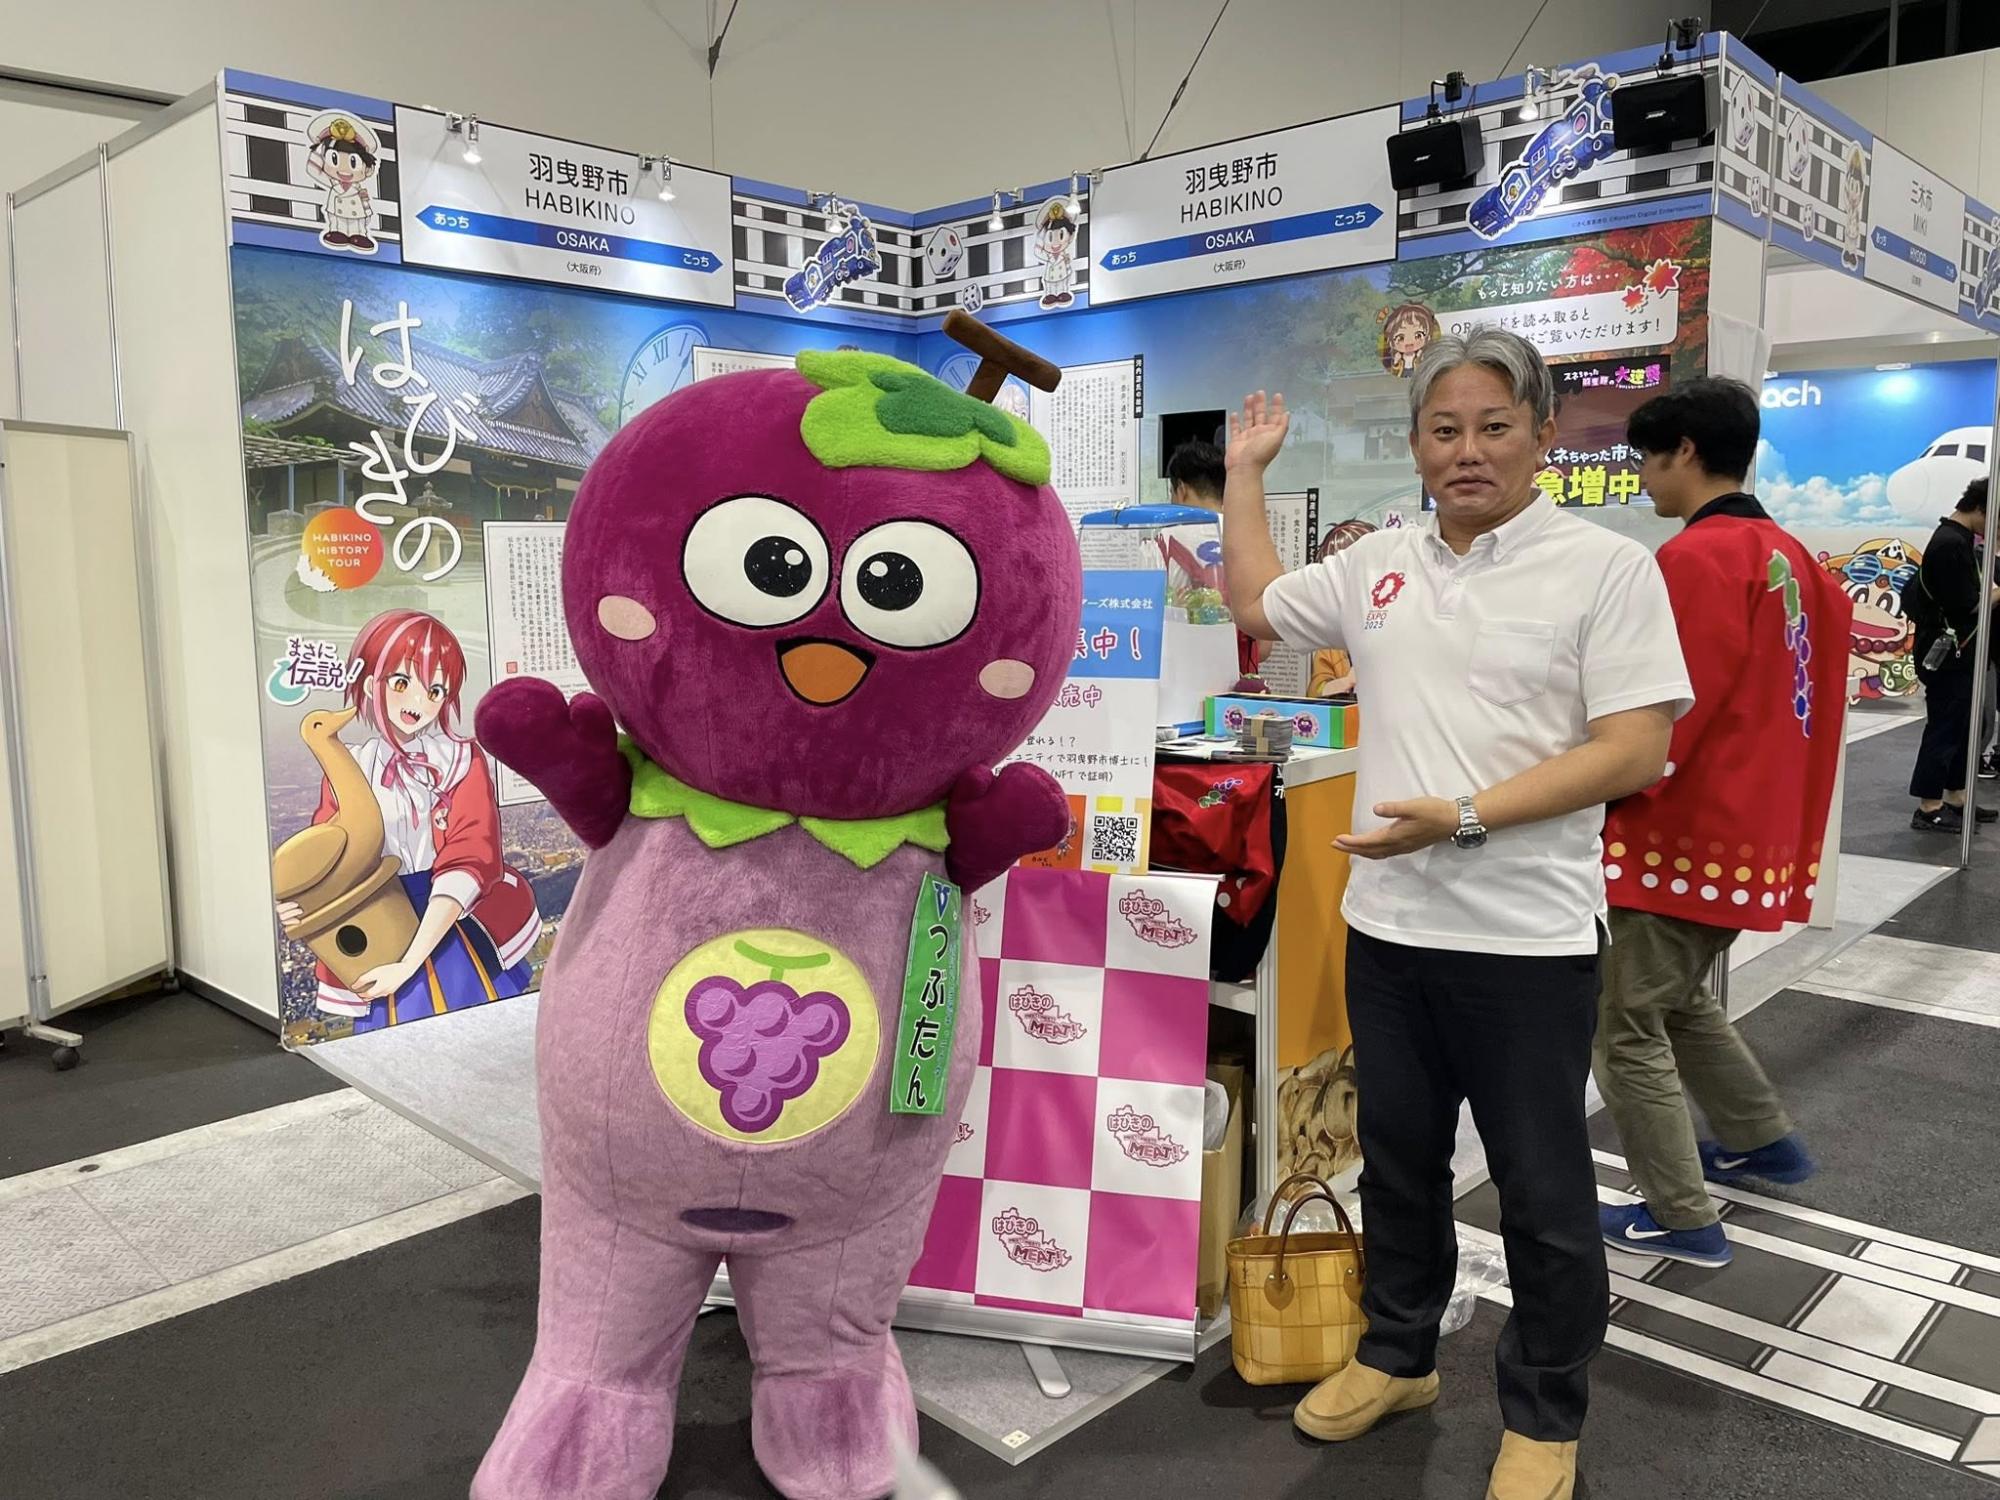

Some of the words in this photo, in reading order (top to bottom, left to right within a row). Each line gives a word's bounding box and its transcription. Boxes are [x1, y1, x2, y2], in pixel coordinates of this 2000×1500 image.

[529, 153, 629, 196] 羽曳野市
[1186, 153, 1278, 194] 羽曳野市
[526, 188, 636, 226] HABIKINO
[1180, 187, 1284, 224] HABIKINO
[434, 211, 470, 229] あっち
[1334, 210, 1366, 228] こっち
[556, 230, 610, 253] OSAKA
[1205, 228, 1255, 250] OSAKA
[683, 252, 709, 268] こっち
[1112, 250, 1137, 265] あっち
[1760, 379, 1821, 409] ach
[339, 299, 480, 582] はびきの
[1535, 465, 1640, 506] 急増中
[312, 533, 372, 542] HABIKINO
[328, 558, 361, 567] TOUR
[1082, 598, 1153, 610] ーズ株式会社
[1366, 611, 1388, 620] EXPO
[1365, 621, 1384, 630] 2025
[289, 638, 334, 660] まさに
[1053, 684, 1102, 708] 売中
[1120, 899, 1162, 913] はびきの
[1141, 925, 1187, 941] MEAT!
[1011, 995, 1052, 1009] はびきの
[905, 923, 950, 1108] つぶたん
[1031, 1020, 1076, 1037] MEAT!
[1109, 1116, 1151, 1130] はびきの
[1129, 1142, 1179, 1159] MEAT!
[994, 1218, 1036, 1233] はびきの
[1013, 1245, 1062, 1263] MEAT!
